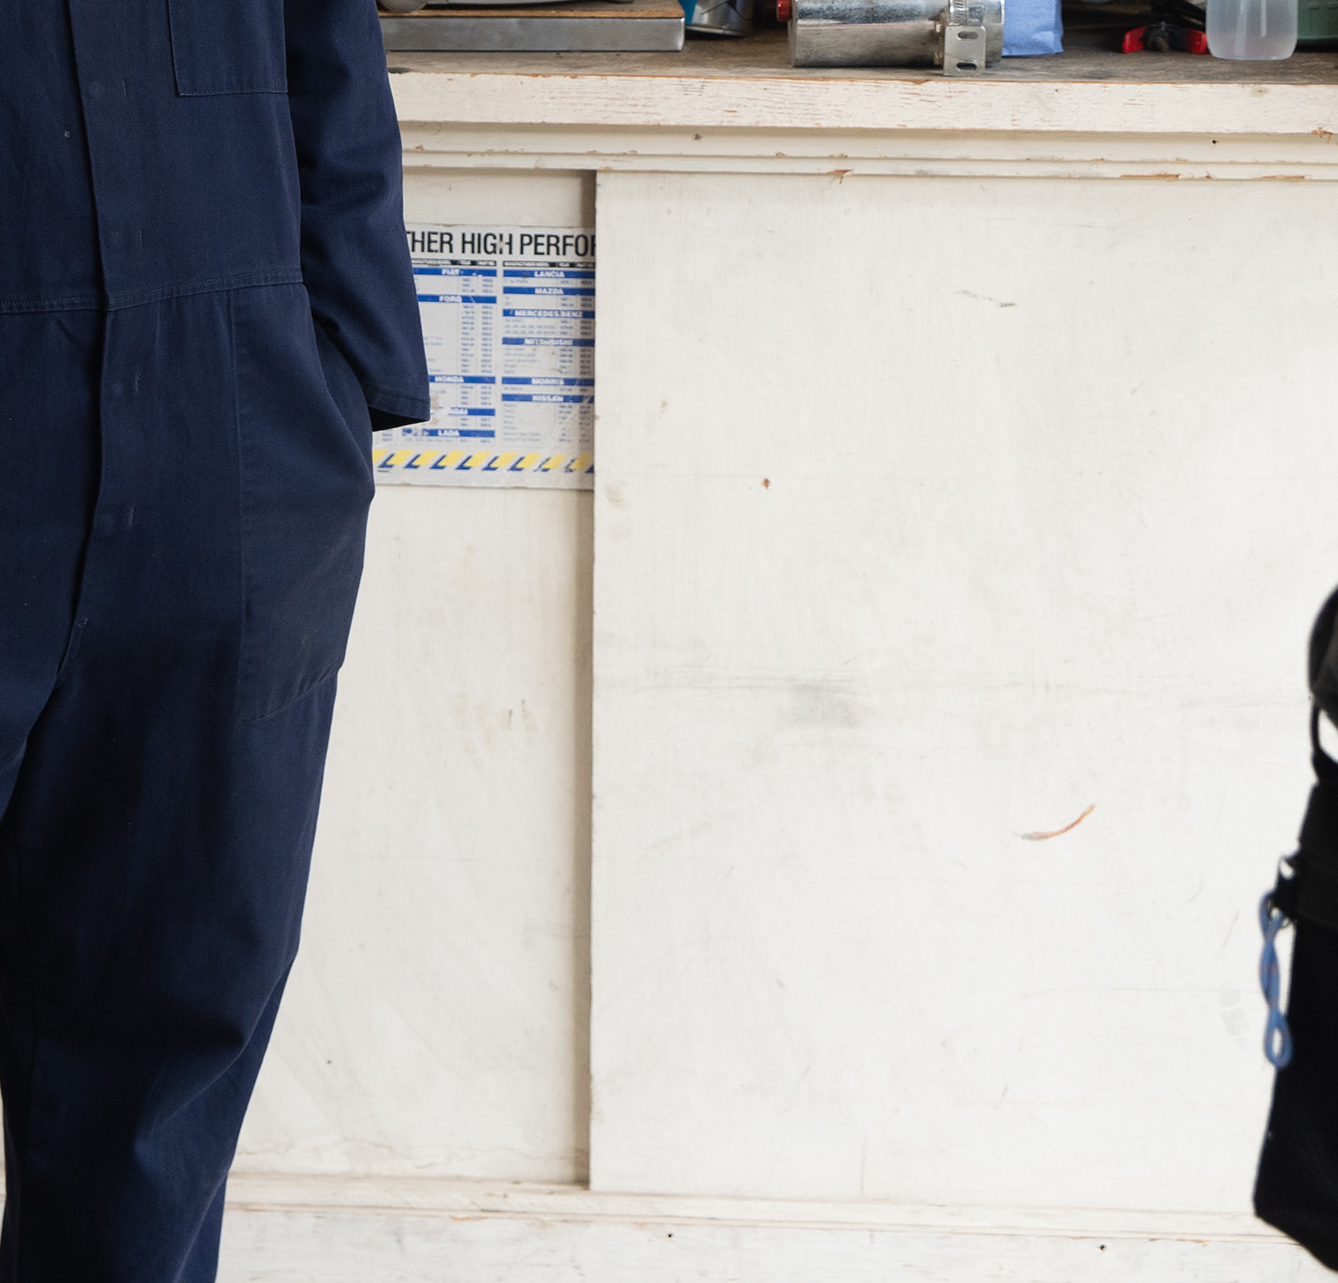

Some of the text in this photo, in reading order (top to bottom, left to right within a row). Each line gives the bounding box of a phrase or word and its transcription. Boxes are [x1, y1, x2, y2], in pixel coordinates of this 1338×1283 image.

[462, 232, 513, 255] HIGH
[534, 270, 565, 278] LANCIA
[535, 287, 564, 296] MAZDA
[439, 294, 463, 303] FORD
[434, 376, 465, 384] HONDA
[532, 395, 564, 403] NISSAN
